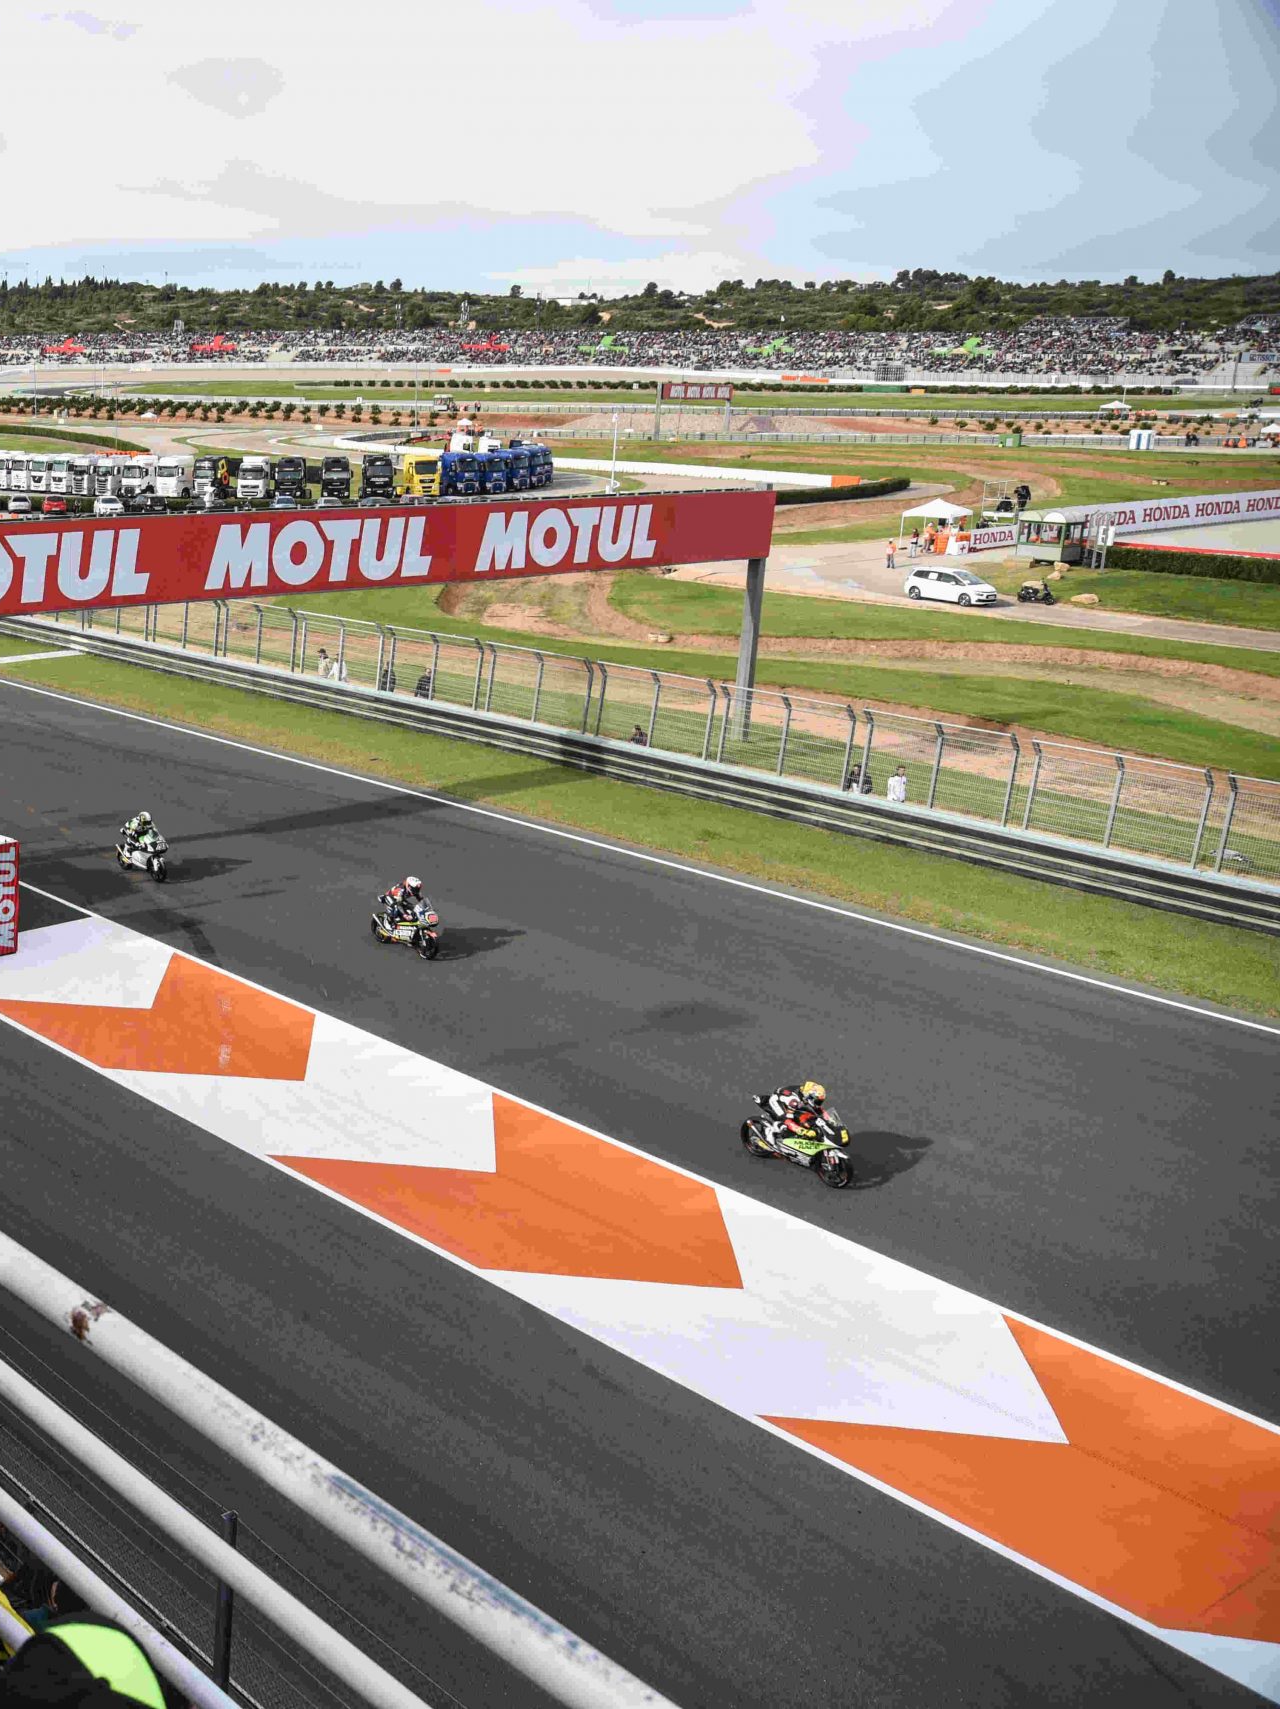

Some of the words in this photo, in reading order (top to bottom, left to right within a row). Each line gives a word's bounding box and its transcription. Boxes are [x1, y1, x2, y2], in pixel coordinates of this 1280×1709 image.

[1142, 504, 1190, 523] HONDA
[1195, 501, 1241, 518] HONDA
[204, 516, 432, 590] MOTUL
[475, 504, 656, 571] MOTUL
[973, 530, 1014, 545] HONDA
